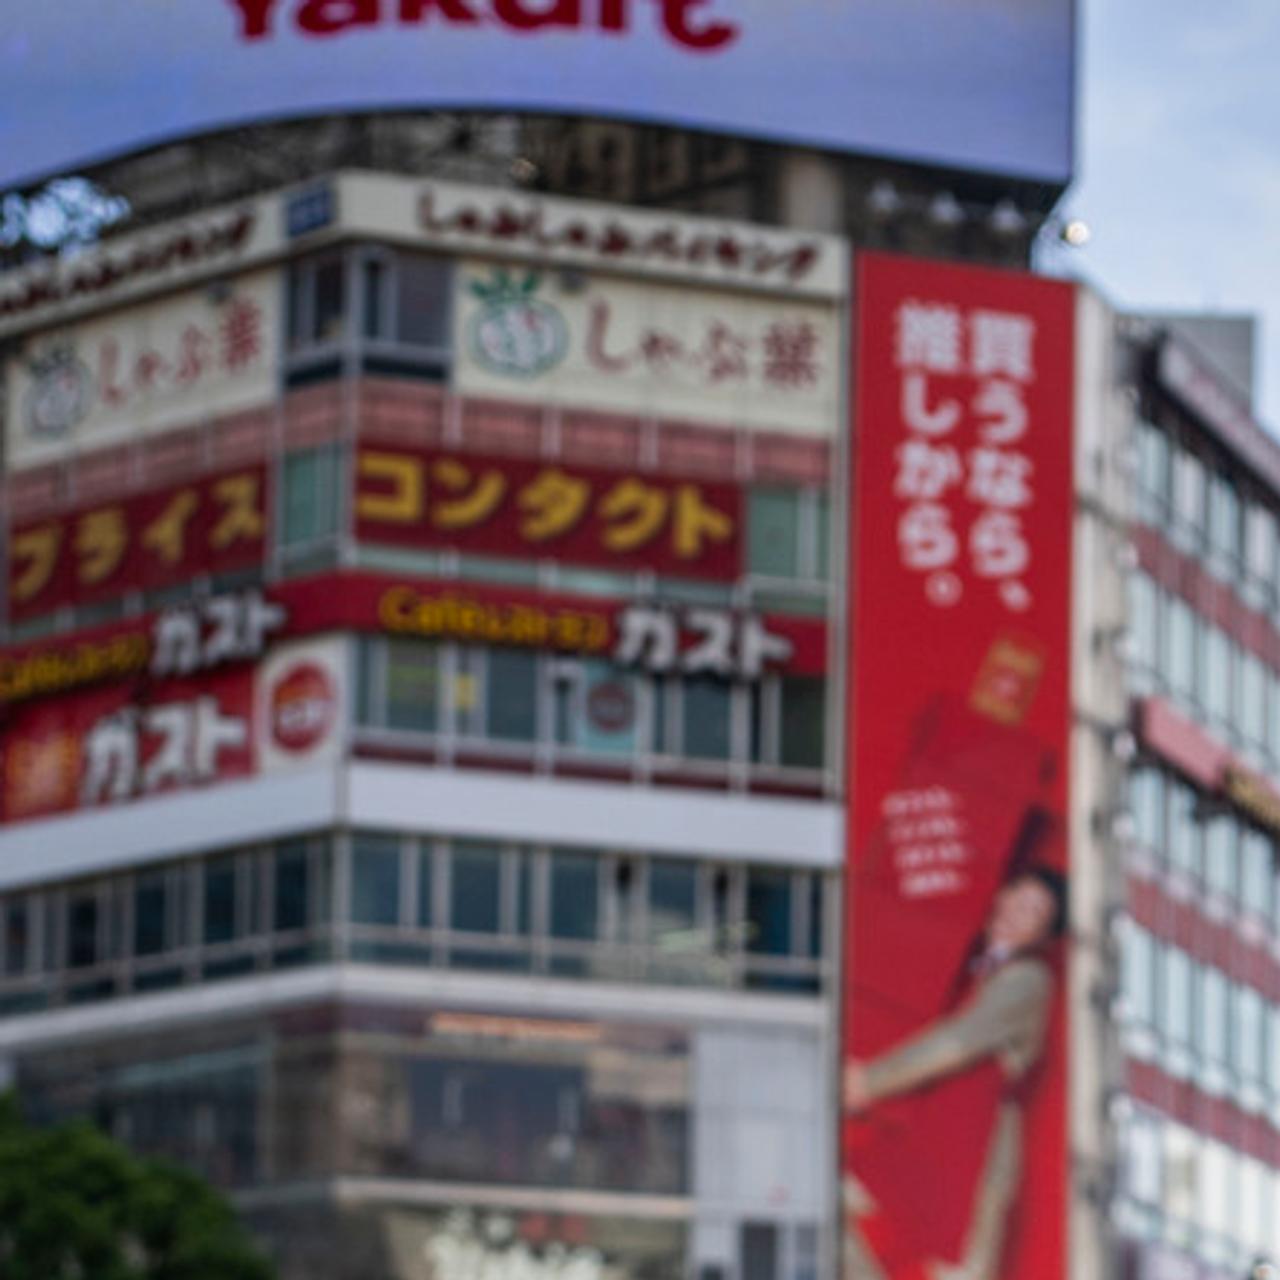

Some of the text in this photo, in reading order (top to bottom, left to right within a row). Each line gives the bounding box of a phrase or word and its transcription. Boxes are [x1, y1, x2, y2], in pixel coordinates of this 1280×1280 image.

[101, 299, 262, 409] しゃぶ葉
[586, 298, 821, 388] しゃぶ葉
[356, 452, 733, 558] コンタクト
[152, 586, 285, 679] ガスト
[616, 602, 795, 678] ガスト
[82, 695, 247, 806] ガスト
